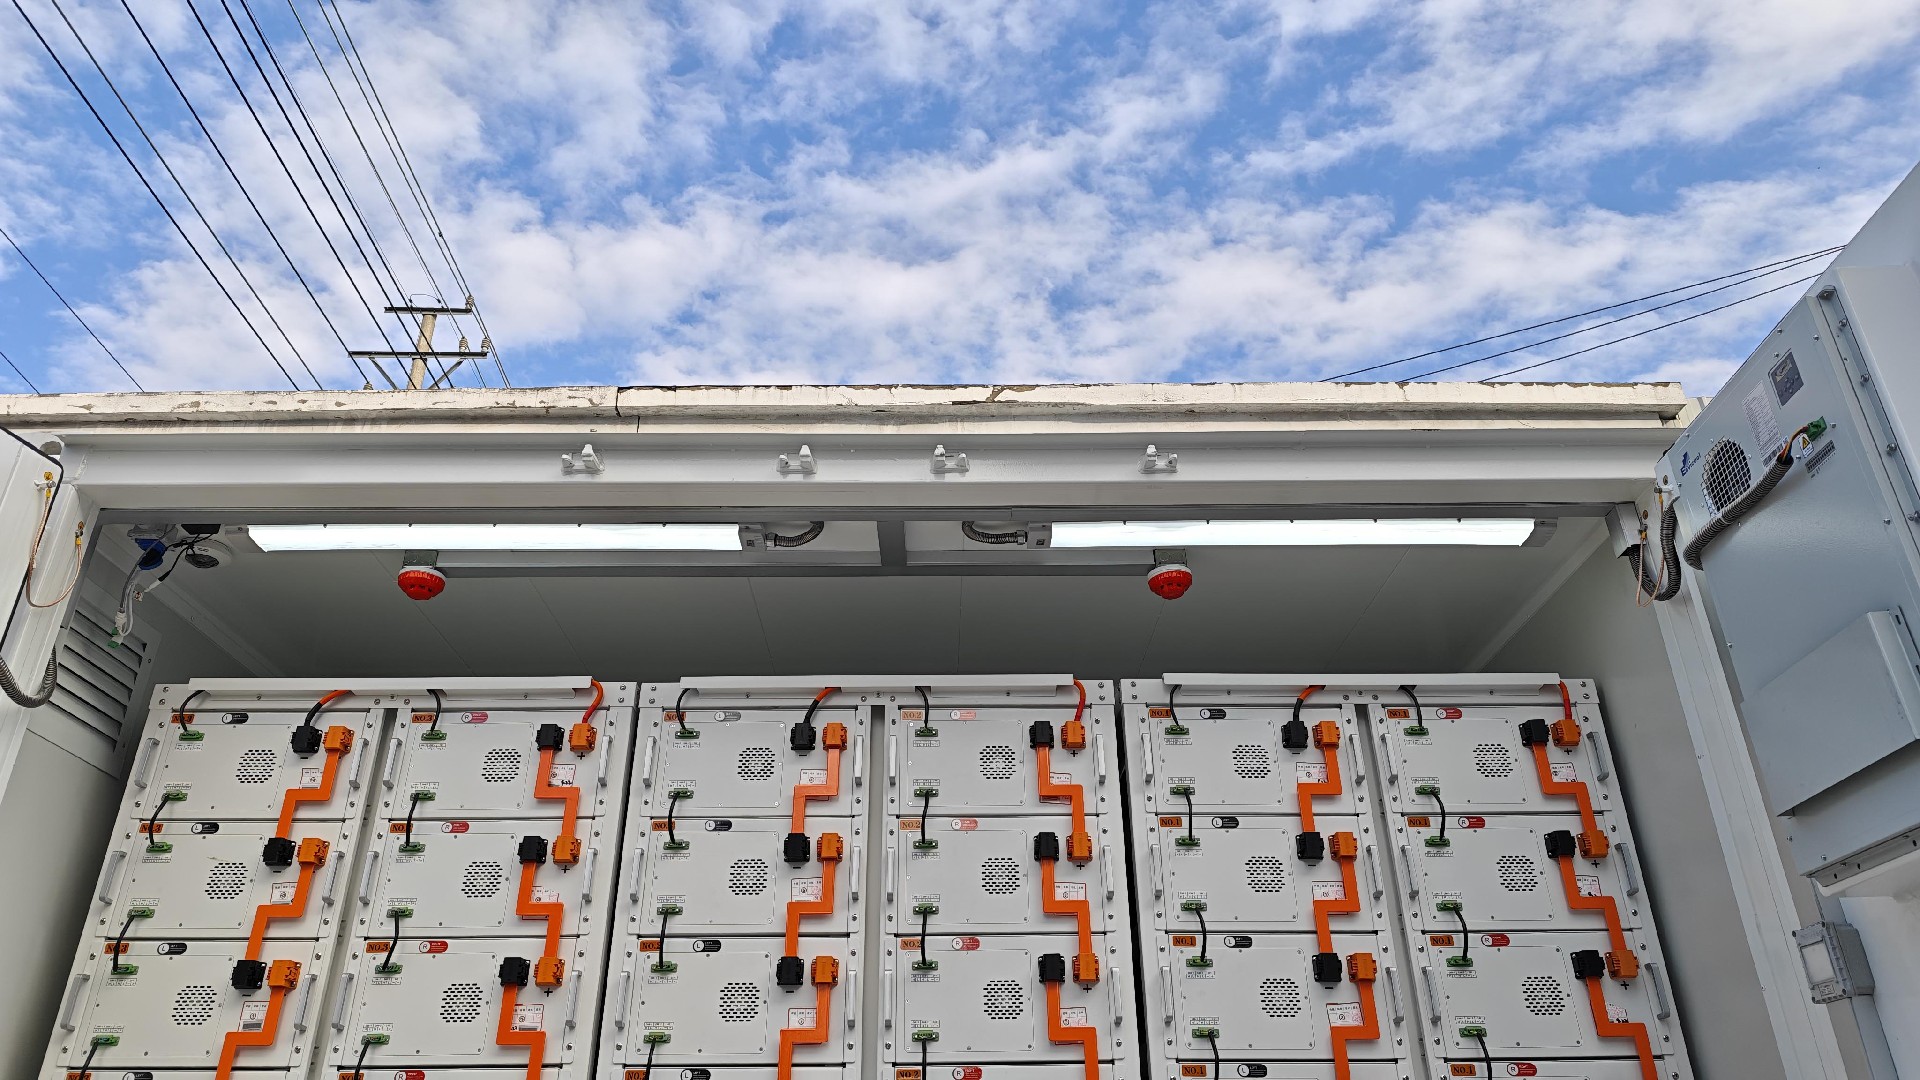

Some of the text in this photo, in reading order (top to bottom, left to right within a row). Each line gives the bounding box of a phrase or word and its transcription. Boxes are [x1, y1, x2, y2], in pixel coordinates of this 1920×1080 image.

[903, 711, 922, 719] NO.2
[902, 820, 921, 829] NO.2
[1161, 818, 1180, 826] NO.1
[1409, 818, 1428, 826] NO.1
[1175, 937, 1194, 946] NO.1
[1432, 936, 1452, 945] NO.1
[368, 943, 389, 952] NO.3
[1184, 1066, 1204, 1074] NO.1
[1453, 1066, 1473, 1074] NO.1
[899, 1070, 919, 1079] NO.2
